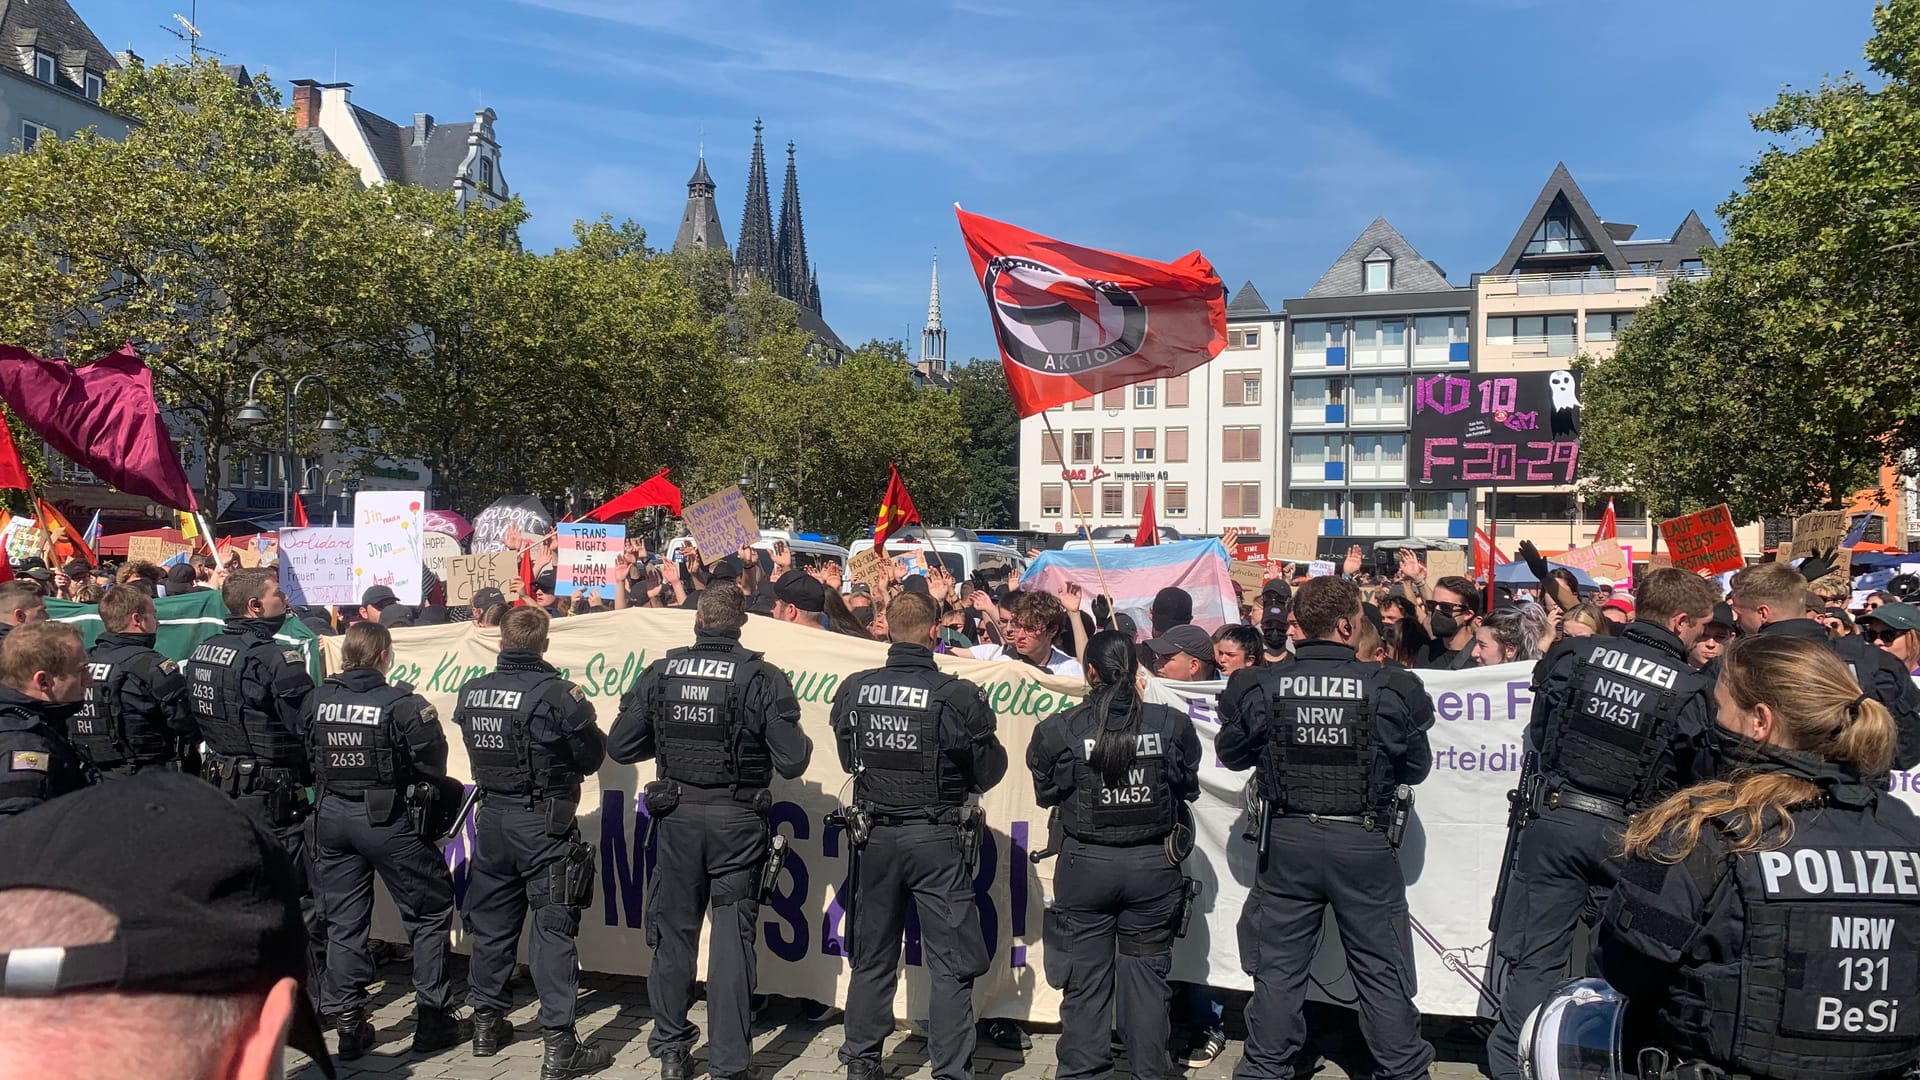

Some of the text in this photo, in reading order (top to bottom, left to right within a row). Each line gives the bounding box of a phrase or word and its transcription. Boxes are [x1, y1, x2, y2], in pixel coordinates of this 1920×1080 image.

[1044, 345, 1123, 370] AKTION
[1478, 378, 1517, 413] 10
[1114, 471, 1155, 480] Immobilien
[1157, 471, 1168, 480] AG
[363, 509, 382, 524] Jin
[690, 503, 717, 520] KNOW
[704, 501, 743, 525] STANDING
[571, 528, 607, 538] TRANS
[696, 514, 740, 542] UP FOR MY
[1662, 518, 1694, 538] LAUF
[368, 542, 392, 559] Jiyan
[575, 541, 607, 552] RIGHTS
[1271, 540, 1312, 556] LEBEN
[1675, 530, 1720, 554] SELBST-
[293, 553, 307, 564] mit
[314, 553, 326, 564] den
[452, 553, 501, 576] FUCK
[329, 571, 335, 580] in
[373, 570, 395, 586] Azadi
[466, 569, 495, 583] THE
[572, 563, 607, 575] HUMAN
[572, 576, 607, 588] RIGHTS
[195, 668, 212, 682] NRW
[388, 651, 421, 688] er
[426, 651, 488, 693] Kam
[665, 658, 735, 679] POLIZEI
[1588, 646, 1678, 689] POLIZEI
[192, 683, 214, 700] 2633
[681, 685, 709, 700] NRW
[858, 684, 929, 708] POLIZEI
[1279, 676, 1363, 699] POLIZEI
[1594, 677, 1645, 707] NRW
[198, 700, 213, 715] RH
[465, 689, 523, 709] POLIZEI
[316, 703, 381, 725] POLIZEI
[672, 705, 714, 723] 31451
[1297, 707, 1344, 724] NRW
[1587, 697, 1640, 729] 31451
[77, 720, 93, 734] RH
[472, 717, 502, 732] NRW
[870, 714, 909, 732] NRW
[327, 732, 362, 745] NRW
[474, 734, 504, 749] 2633
[865, 732, 917, 750] 31452
[1297, 726, 1347, 745] 31451
[1084, 733, 1162, 761] PZEI
[330, 753, 365, 767] 2633
[1101, 786, 1151, 804] 31452
[1830, 916, 1895, 950] NRW
[1838, 957, 1890, 991] 131
[1816, 997, 1899, 1033] BeSi
